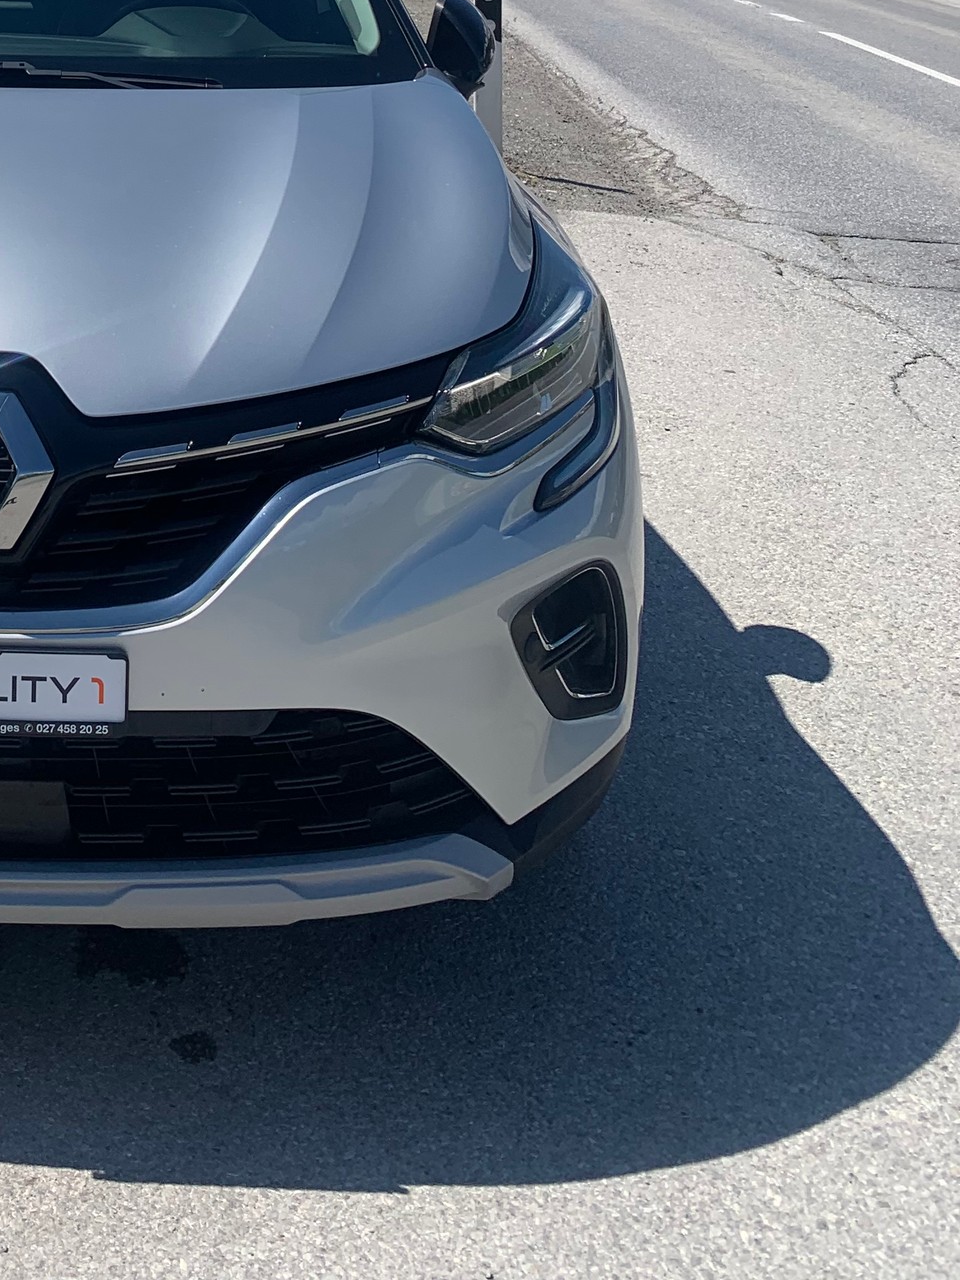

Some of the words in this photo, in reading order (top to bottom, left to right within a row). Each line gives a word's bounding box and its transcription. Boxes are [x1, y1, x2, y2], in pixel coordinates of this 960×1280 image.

[91, 676, 105, 705] 1
[36, 723, 56, 734] 027
[57, 724, 77, 734] 458
[79, 725, 93, 734] 20
[95, 725, 109, 735] 25
